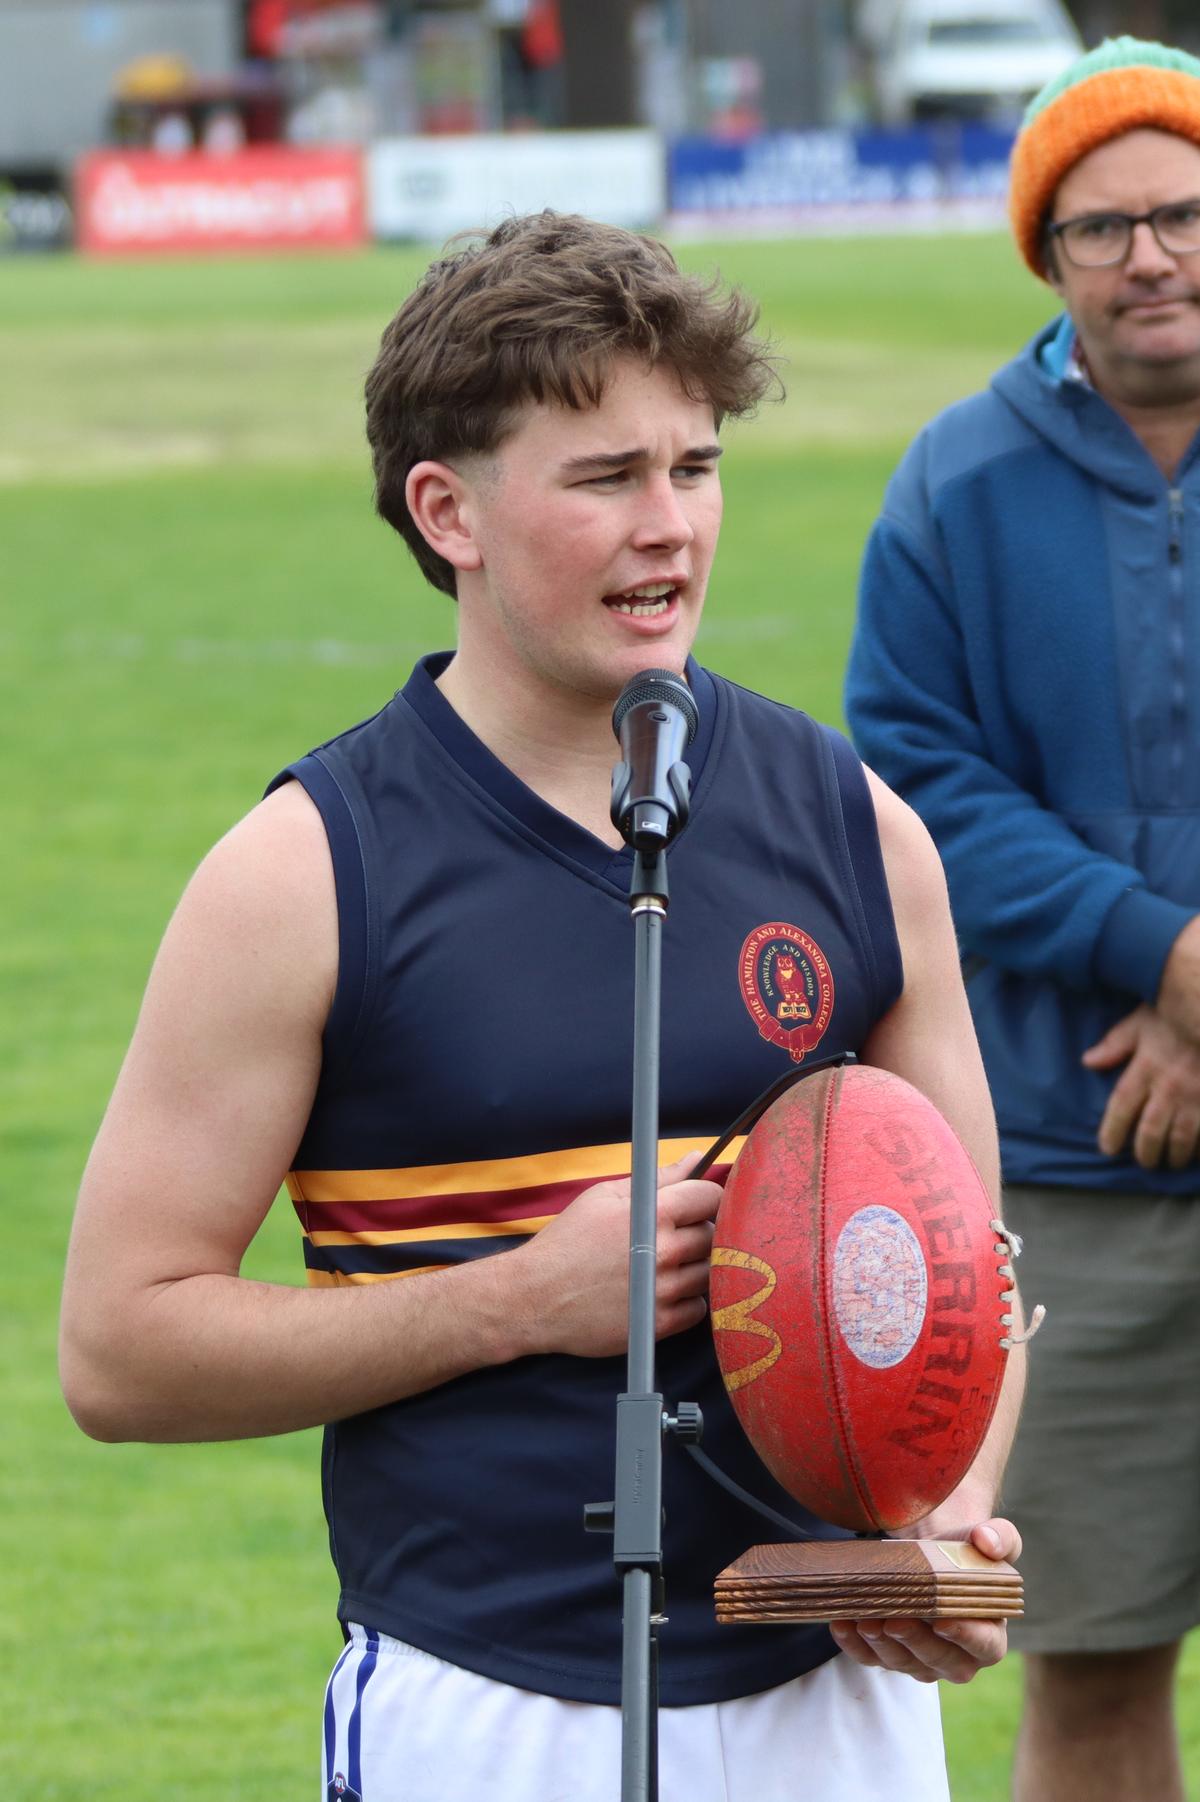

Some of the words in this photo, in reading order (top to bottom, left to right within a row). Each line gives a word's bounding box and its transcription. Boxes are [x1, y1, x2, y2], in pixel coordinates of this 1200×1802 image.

[757, 927, 777, 941] AND
[780, 927, 828, 979] ALEXANDRA
[744, 940, 759, 995] HAMILTON
[763, 945, 779, 997] KNOWLEDGE
[782, 944, 801, 958] AND
[800, 960, 814, 996] WISDOM
[750, 999, 767, 1020] THE
[816, 984, 830, 1031] COLLEGE
[862, 1123, 978, 1458] SHERRIN
